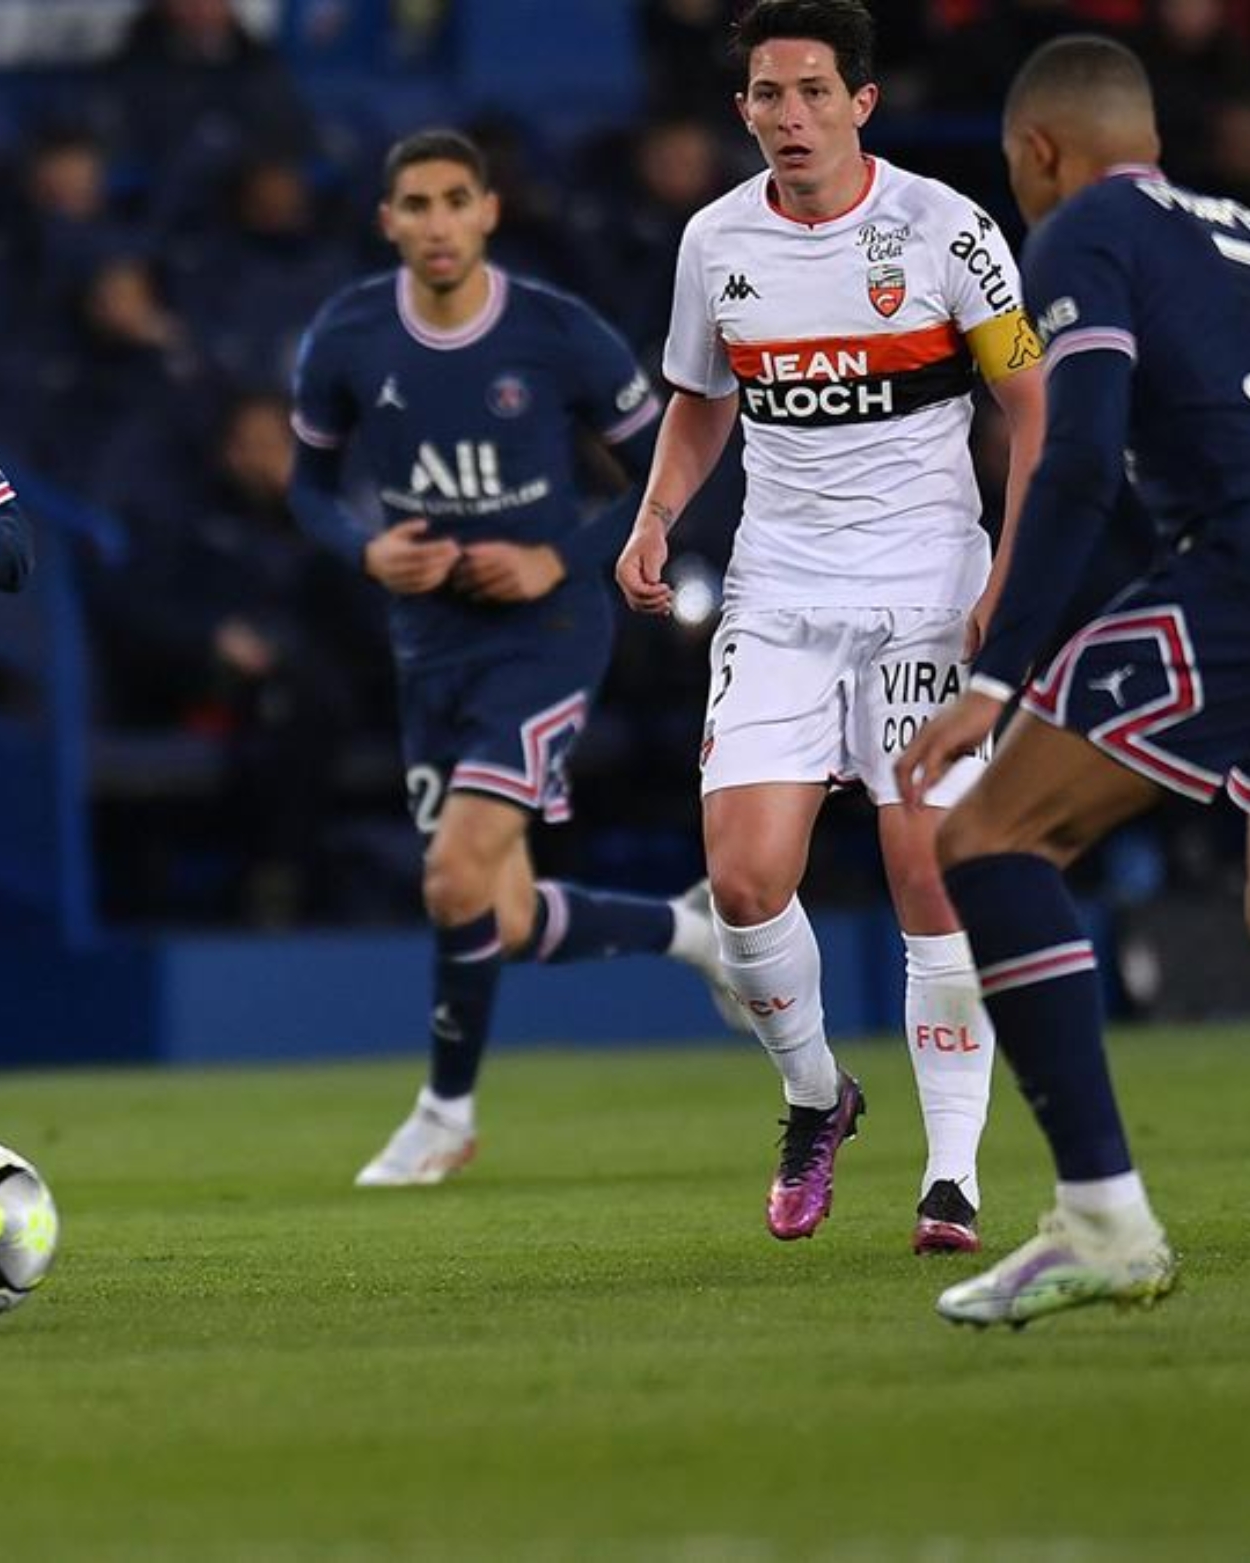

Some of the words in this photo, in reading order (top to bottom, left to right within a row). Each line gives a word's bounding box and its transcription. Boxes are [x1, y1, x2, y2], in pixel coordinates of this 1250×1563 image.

[867, 242, 903, 262] Cola
[949, 230, 1018, 318] actu
[756, 350, 868, 385] JEAN
[880, 661, 961, 704] VIRA
[406, 764, 442, 834] 2
[916, 1024, 980, 1052] FCL
